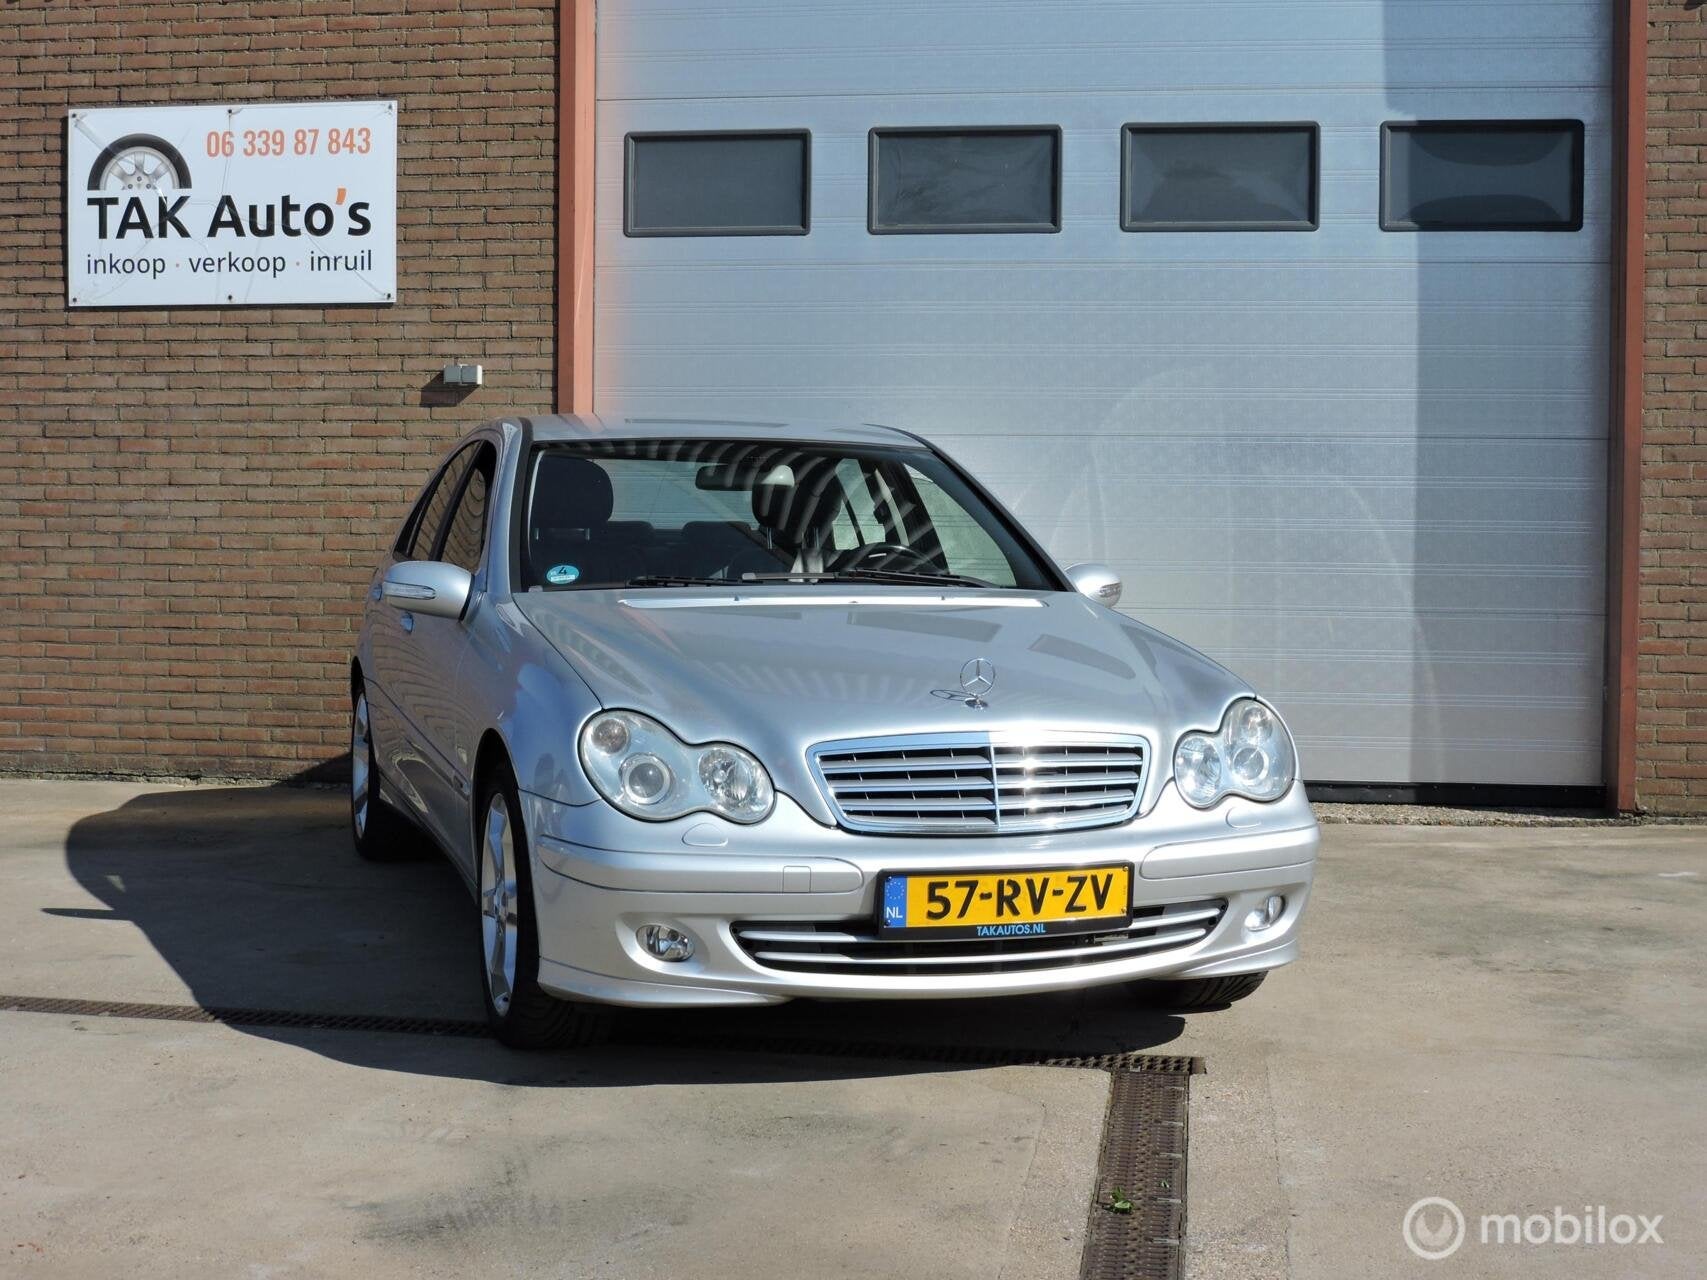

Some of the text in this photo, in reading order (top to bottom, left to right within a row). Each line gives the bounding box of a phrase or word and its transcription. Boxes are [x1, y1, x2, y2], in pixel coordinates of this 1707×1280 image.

[206, 127, 372, 157] 06 339 87 843
[86, 187, 371, 240] TAK Auto's
[86, 249, 372, 279] inkoop verkoop inruil
[926, 873, 1114, 920] 57-RV-ZV
[886, 907, 903, 919] NL
[976, 924, 1047, 937] TAKAUTOS.NL
